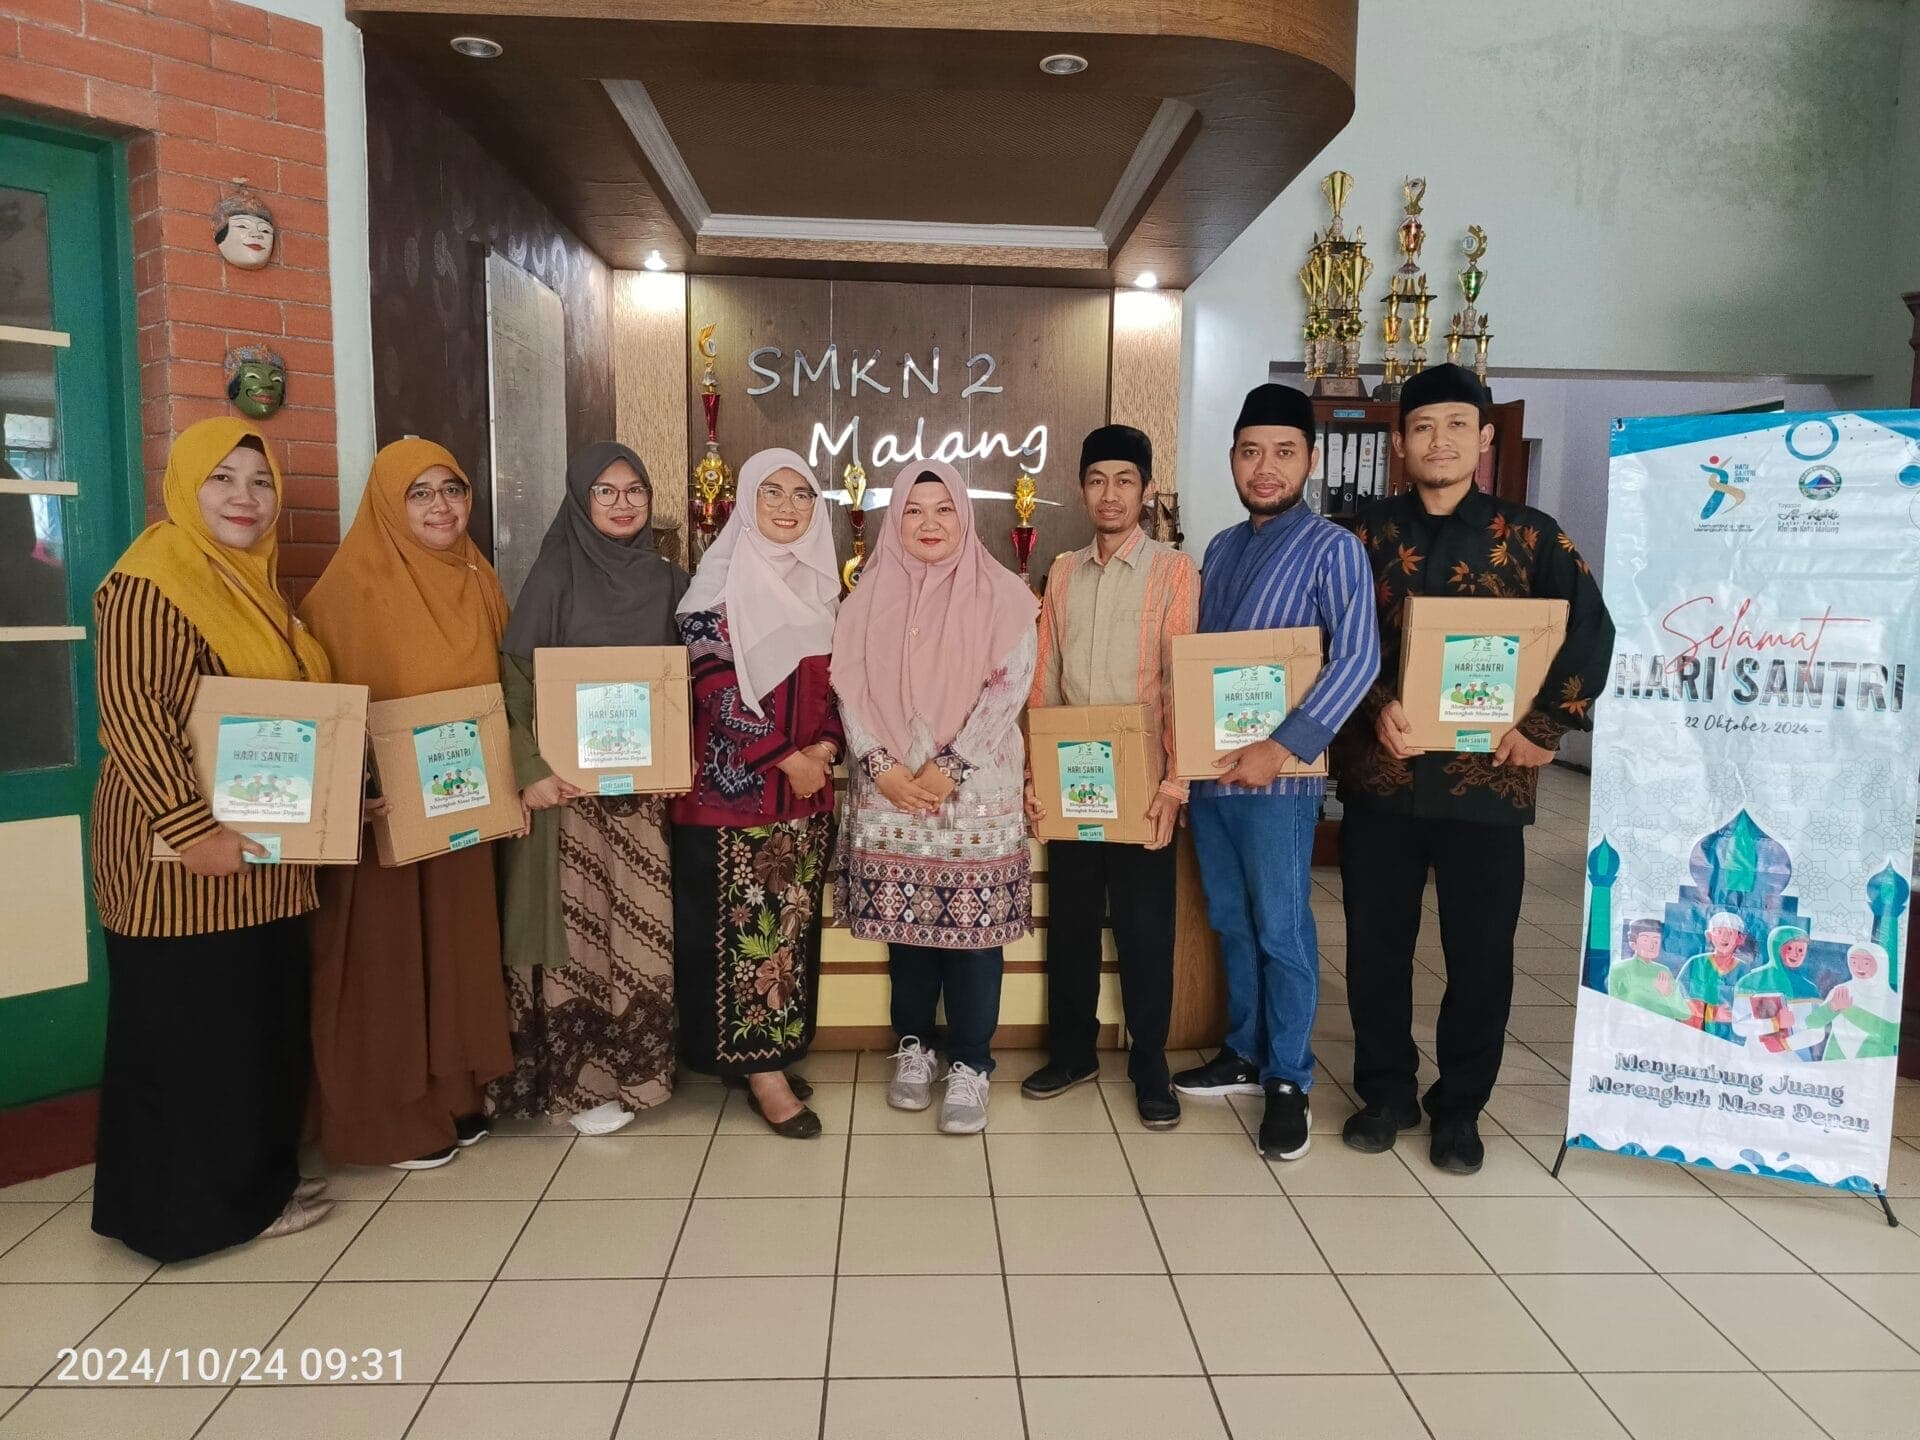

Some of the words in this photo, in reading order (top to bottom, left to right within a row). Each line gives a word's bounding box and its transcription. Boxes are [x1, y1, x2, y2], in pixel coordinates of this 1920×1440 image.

[747, 344, 940, 398] SMKN
[962, 353, 1003, 398] 2
[809, 415, 1048, 474] Malang
[1662, 596, 1871, 683] Selamat
[1455, 663, 1473, 672] HARI
[1476, 663, 1504, 672] SANTRI
[1614, 653, 1716, 700] HARI
[1732, 656, 1905, 713] SANTRI
[1225, 692, 1243, 702] HARI
[1245, 691, 1273, 701] SANTRI
[588, 710, 607, 719] HARI
[609, 709, 637, 719] SANTRI
[1684, 715, 1698, 729] 22
[1704, 713, 1770, 732] Oktober
[1774, 720, 1808, 734] 2024
[233, 750, 257, 761] HARI
[261, 751, 299, 762] SANTRI
[428, 752, 445, 764] HARI
[446, 748, 471, 760] SANTRI
[1083, 766, 1104, 774] SANTRI
[1615, 1052, 1763, 1092] Menyambung
[1769, 1074, 1845, 1107] Juang
[1589, 1074, 1711, 1107] Merengkuh
[1718, 1092, 1785, 1119] Masa
[1792, 1103, 1870, 1133] Depan
